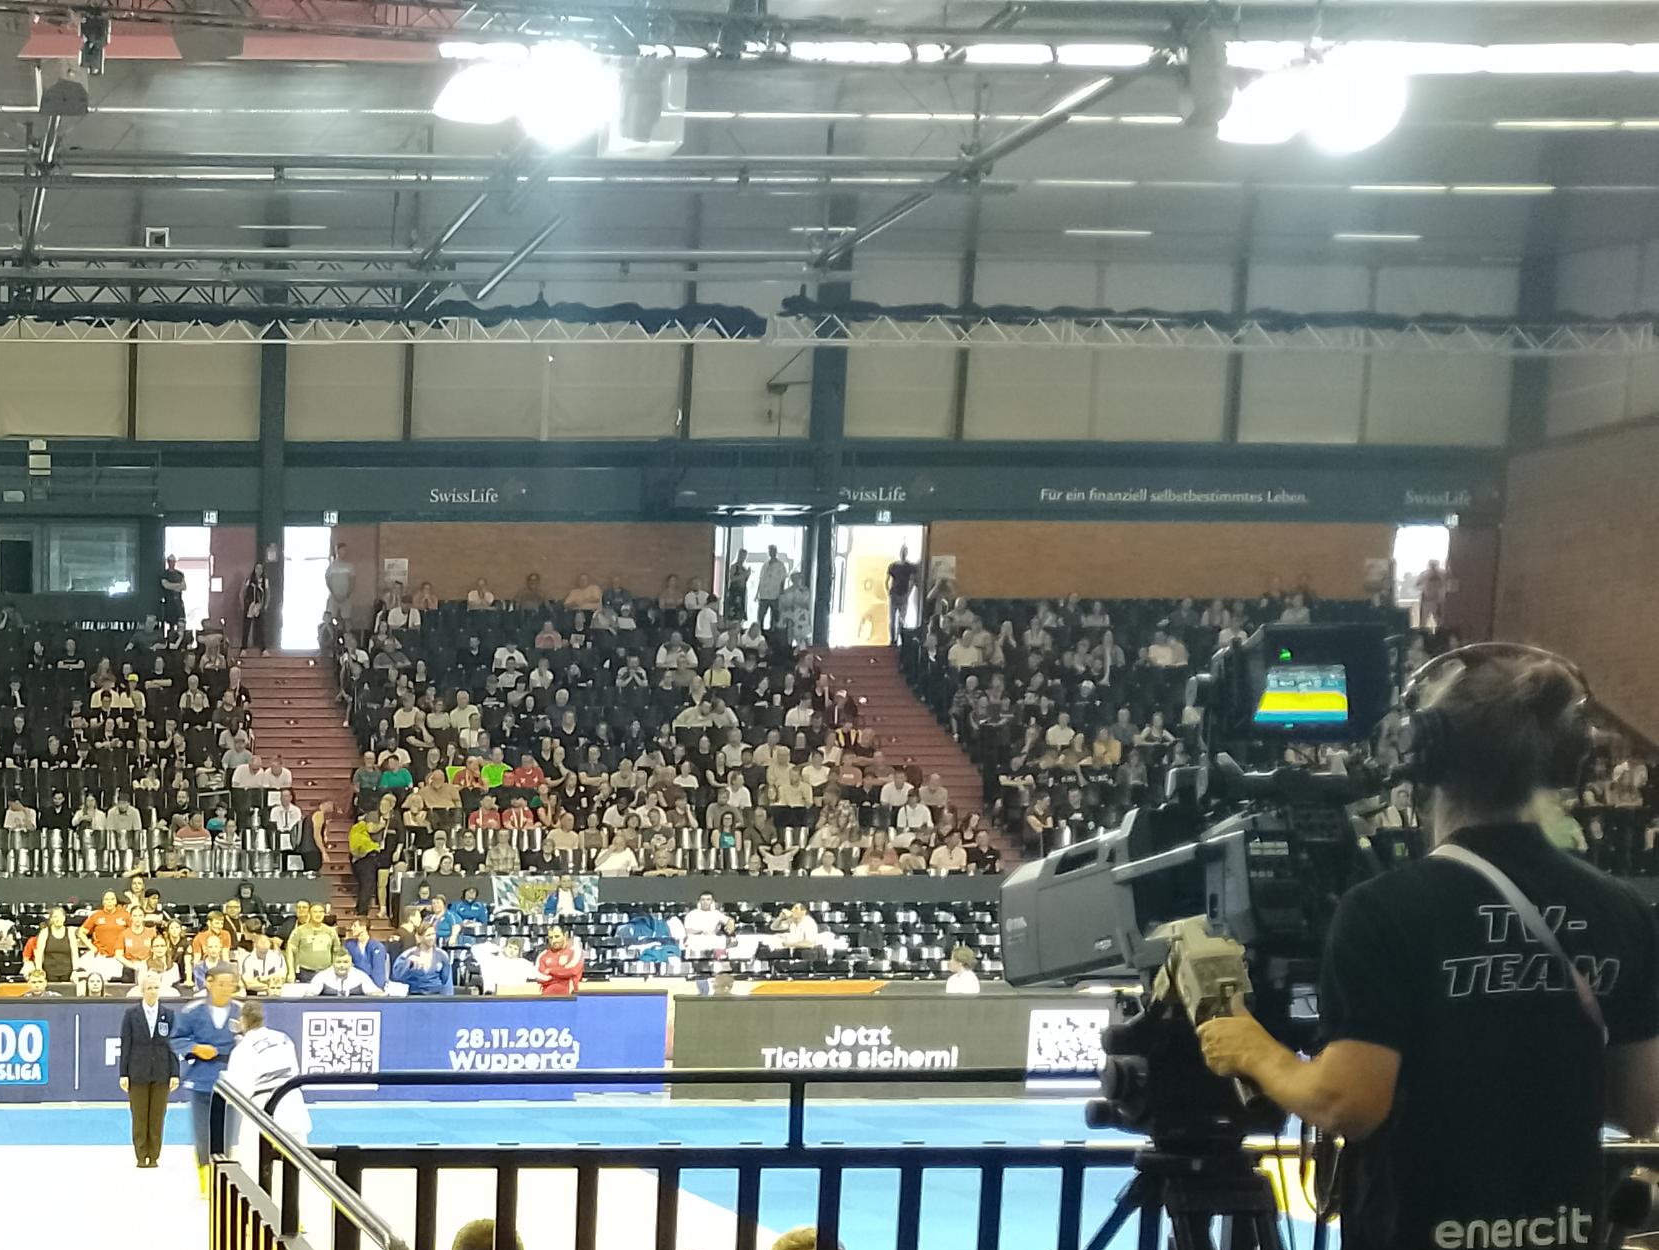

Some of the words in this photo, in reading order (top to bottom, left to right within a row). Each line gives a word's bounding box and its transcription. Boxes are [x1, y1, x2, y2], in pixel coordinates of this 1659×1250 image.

[429, 487, 499, 503] SwissLife
[1066, 488, 1085, 500] ein
[1089, 487, 1147, 501] finanziell
[1478, 904, 1587, 942] TV-
[1443, 953, 1620, 997] TEAM
[455, 1028, 573, 1049] 28.11.2026
[825, 1025, 891, 1046] Jetzt
[761, 1046, 852, 1069] Tickets
